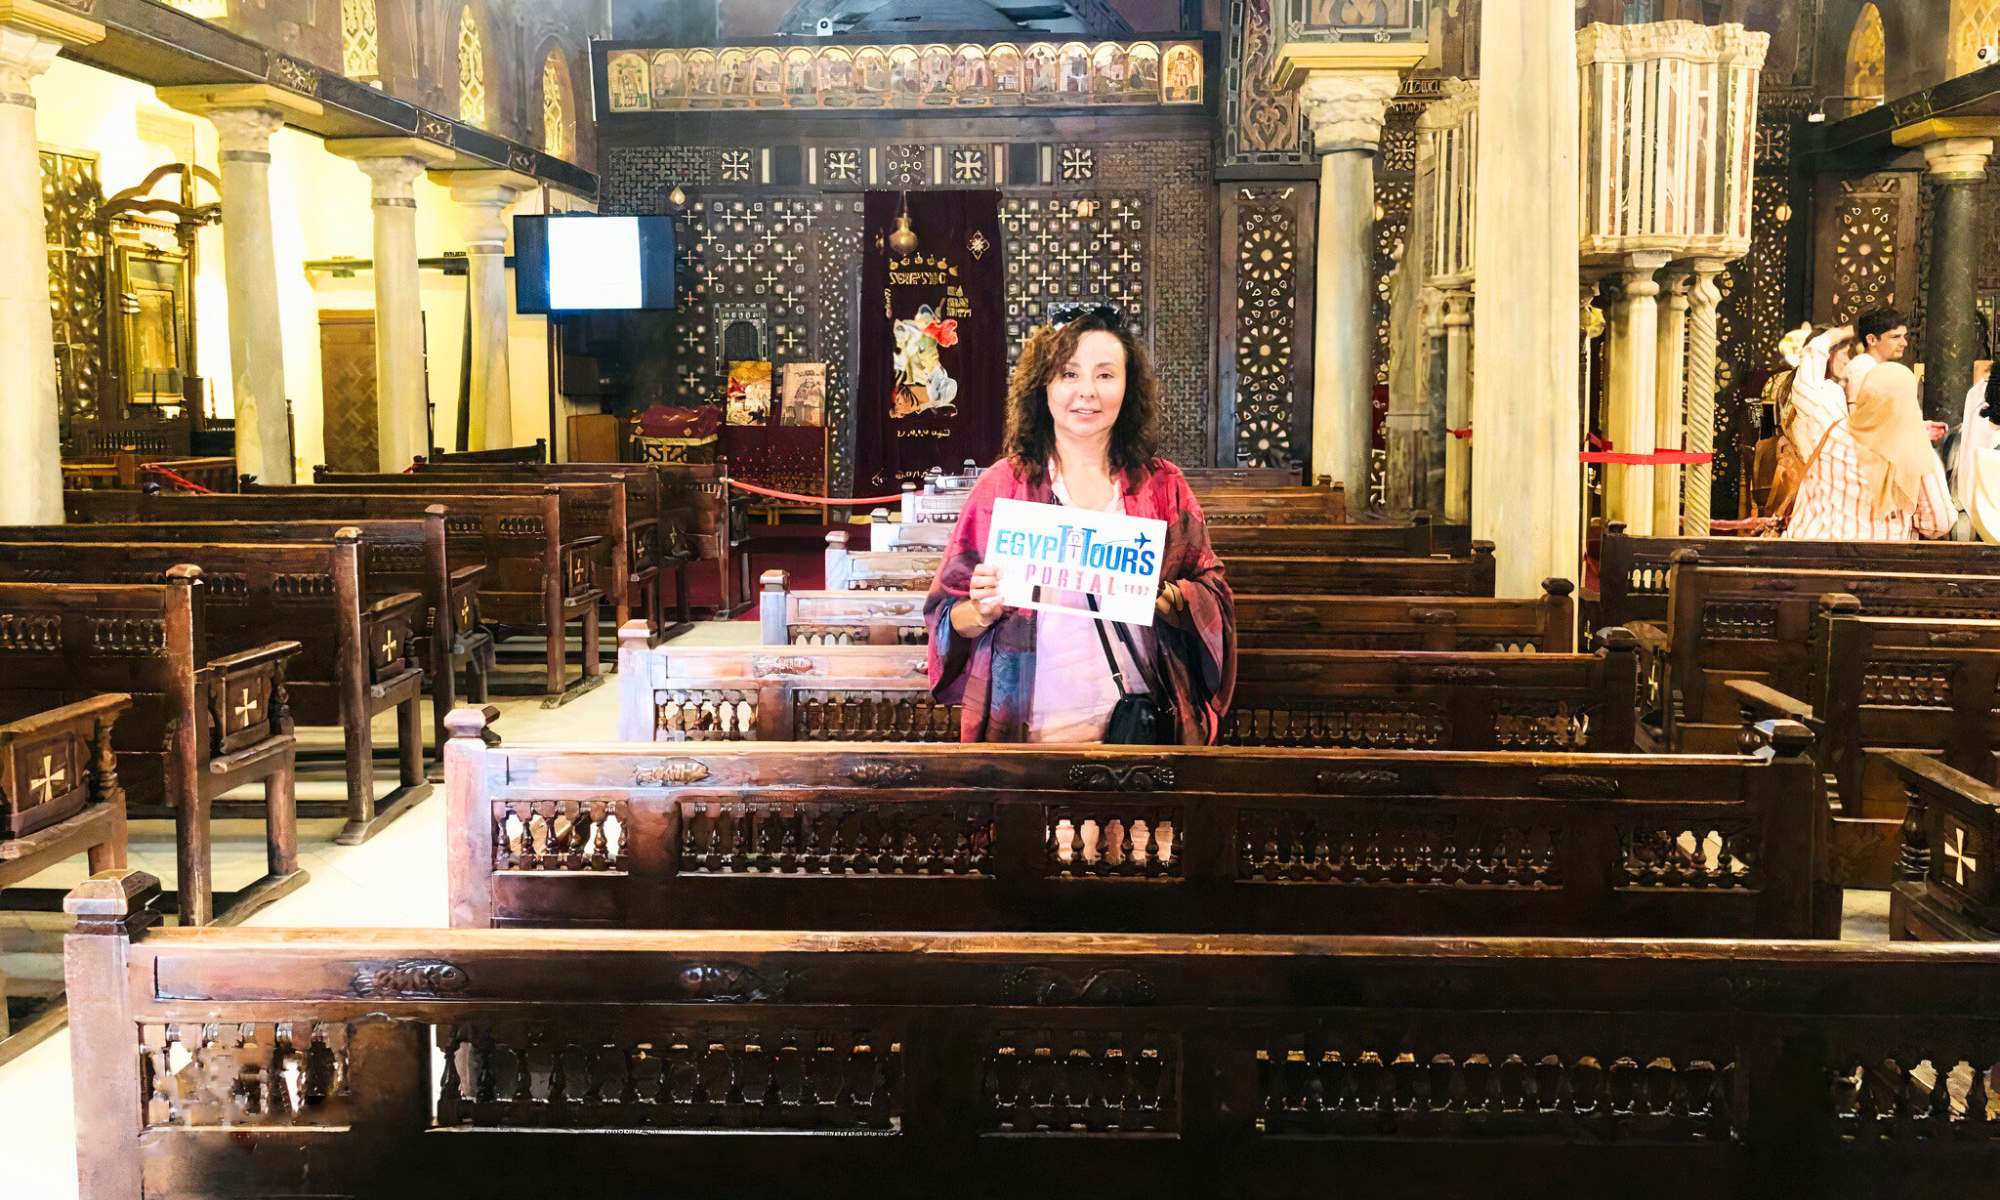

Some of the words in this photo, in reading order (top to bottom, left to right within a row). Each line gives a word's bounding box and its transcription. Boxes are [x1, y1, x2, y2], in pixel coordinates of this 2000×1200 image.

[995, 525, 1073, 563] EGYPT
[1080, 527, 1155, 576] TOURS
[1026, 564, 1116, 596] PORTAL
